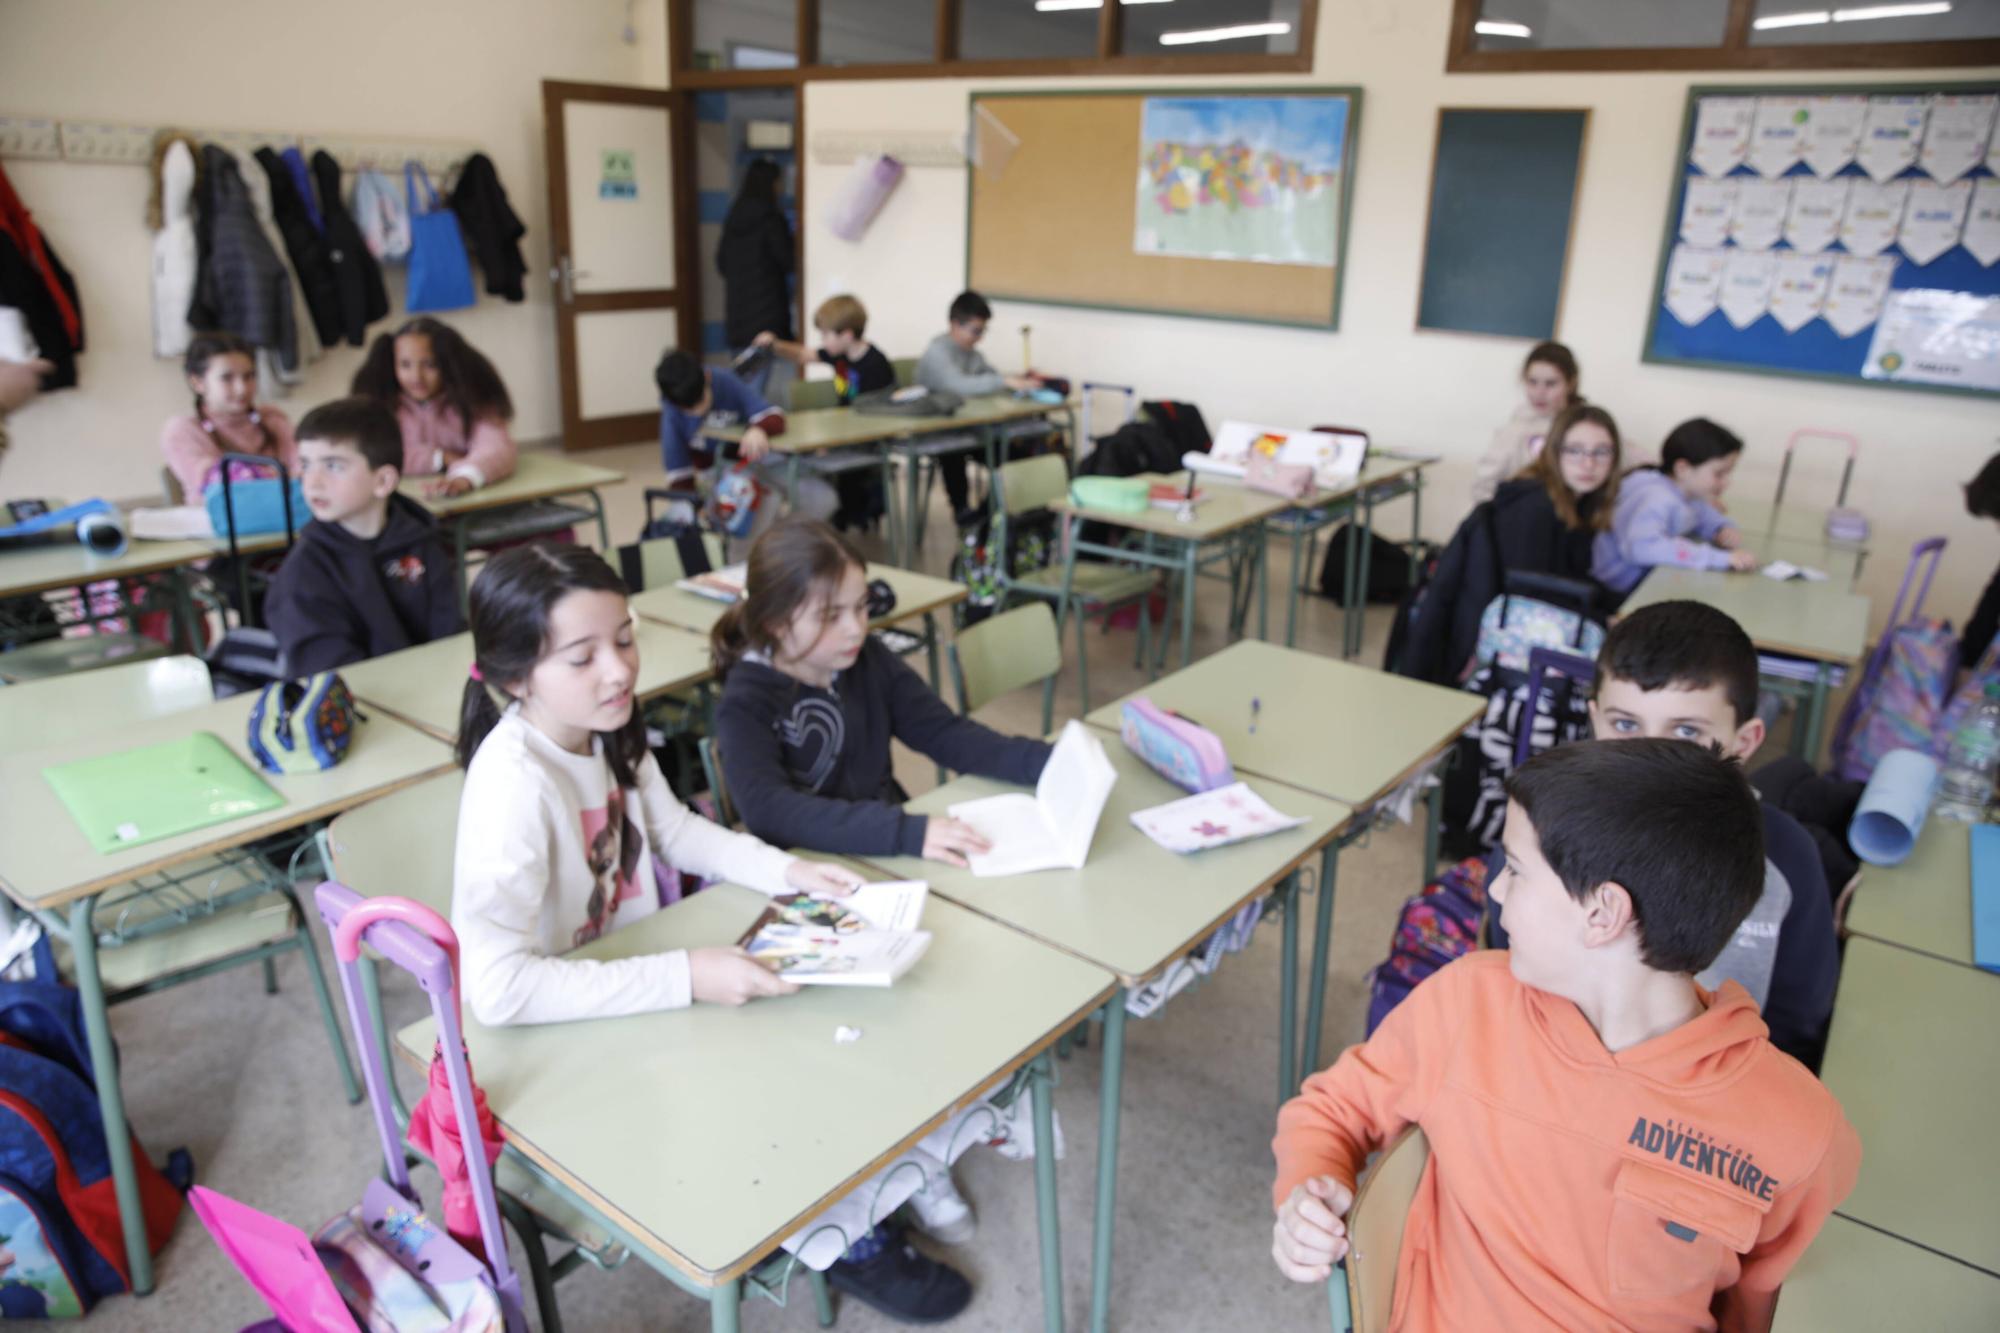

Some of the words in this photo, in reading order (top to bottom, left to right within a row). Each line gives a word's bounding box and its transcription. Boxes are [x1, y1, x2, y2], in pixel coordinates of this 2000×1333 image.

[1627, 1116, 1779, 1202] ADVENTURE
[1666, 1119, 1714, 1143] READY
[1725, 1144, 1753, 1161] FOR
